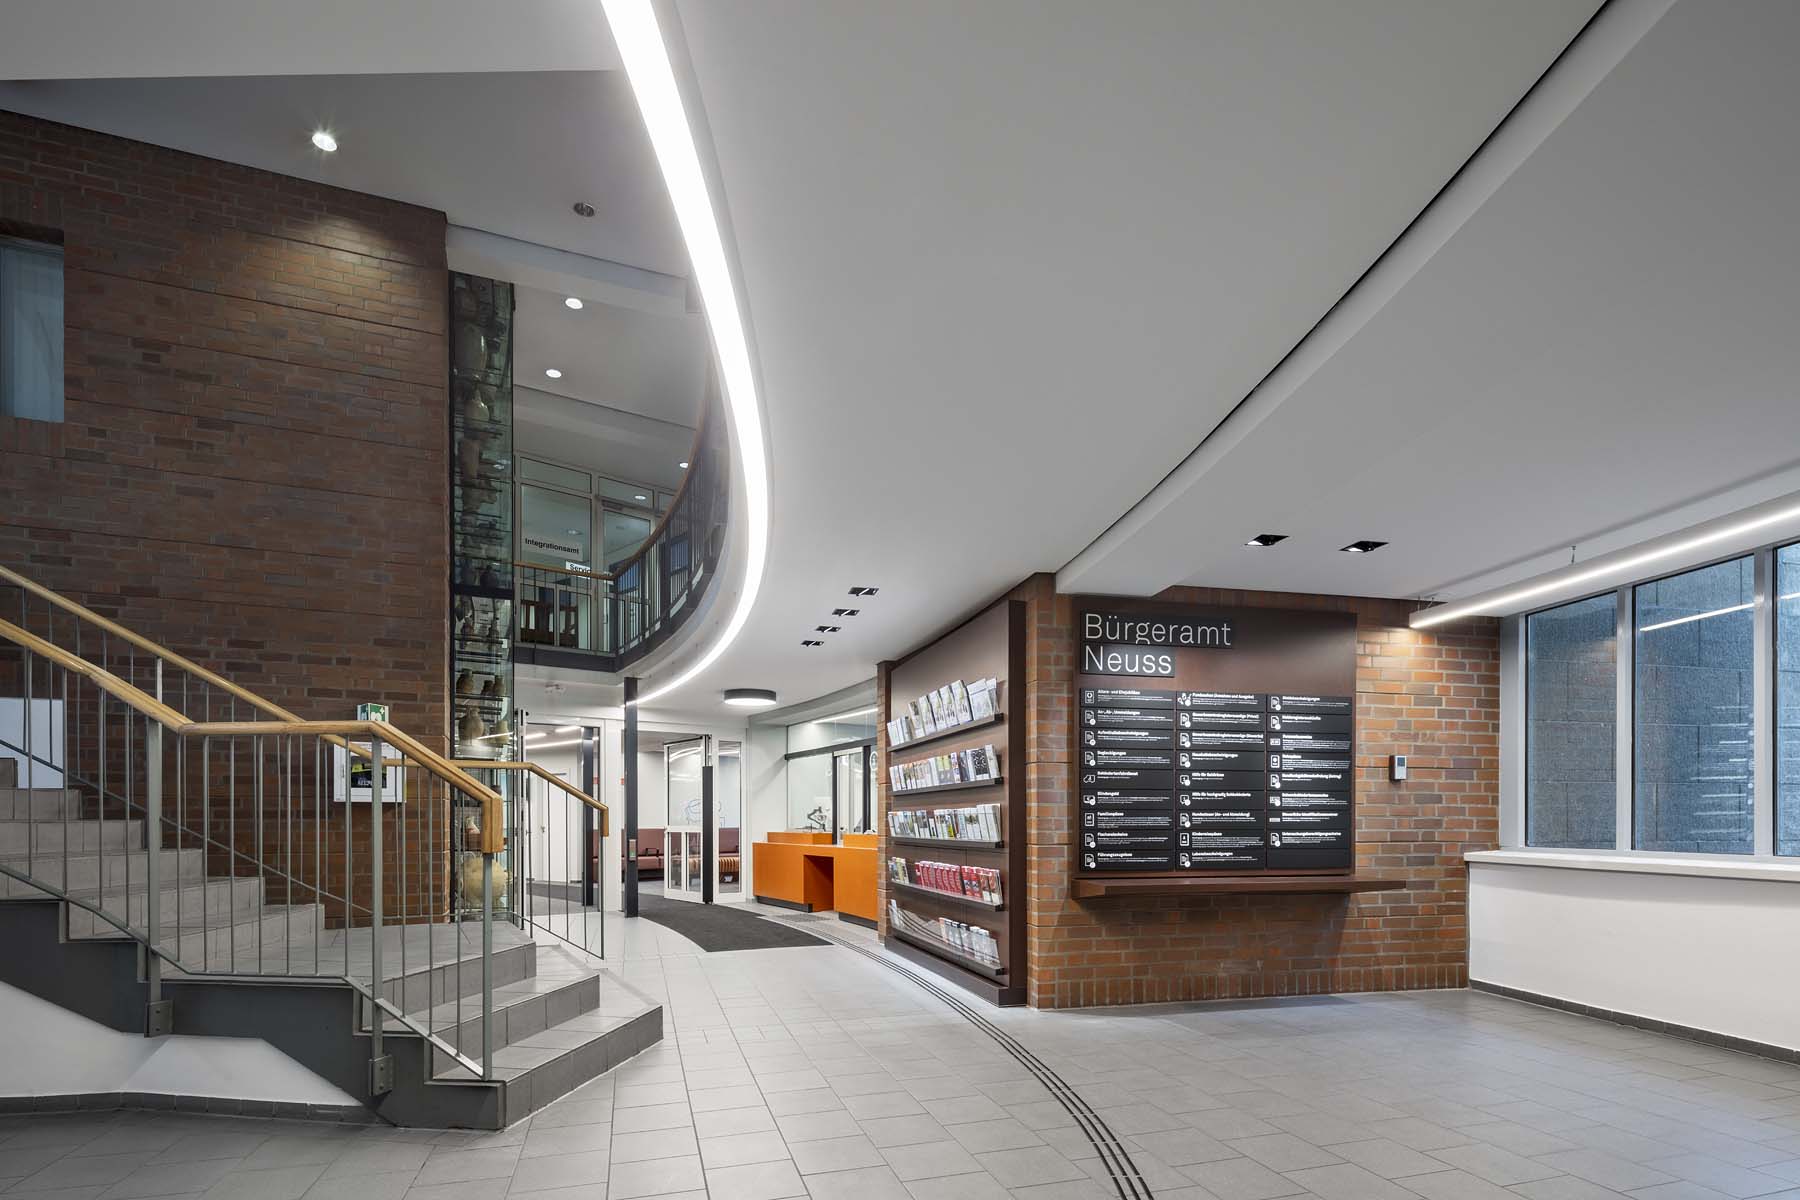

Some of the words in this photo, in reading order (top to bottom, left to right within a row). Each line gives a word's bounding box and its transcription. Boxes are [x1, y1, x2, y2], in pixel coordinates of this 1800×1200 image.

[525, 538, 580, 554] Integrationsamt
[569, 563, 592, 574] Servic
[1085, 613, 1231, 646] Bürgeramt
[1085, 645, 1172, 674] Neuss
